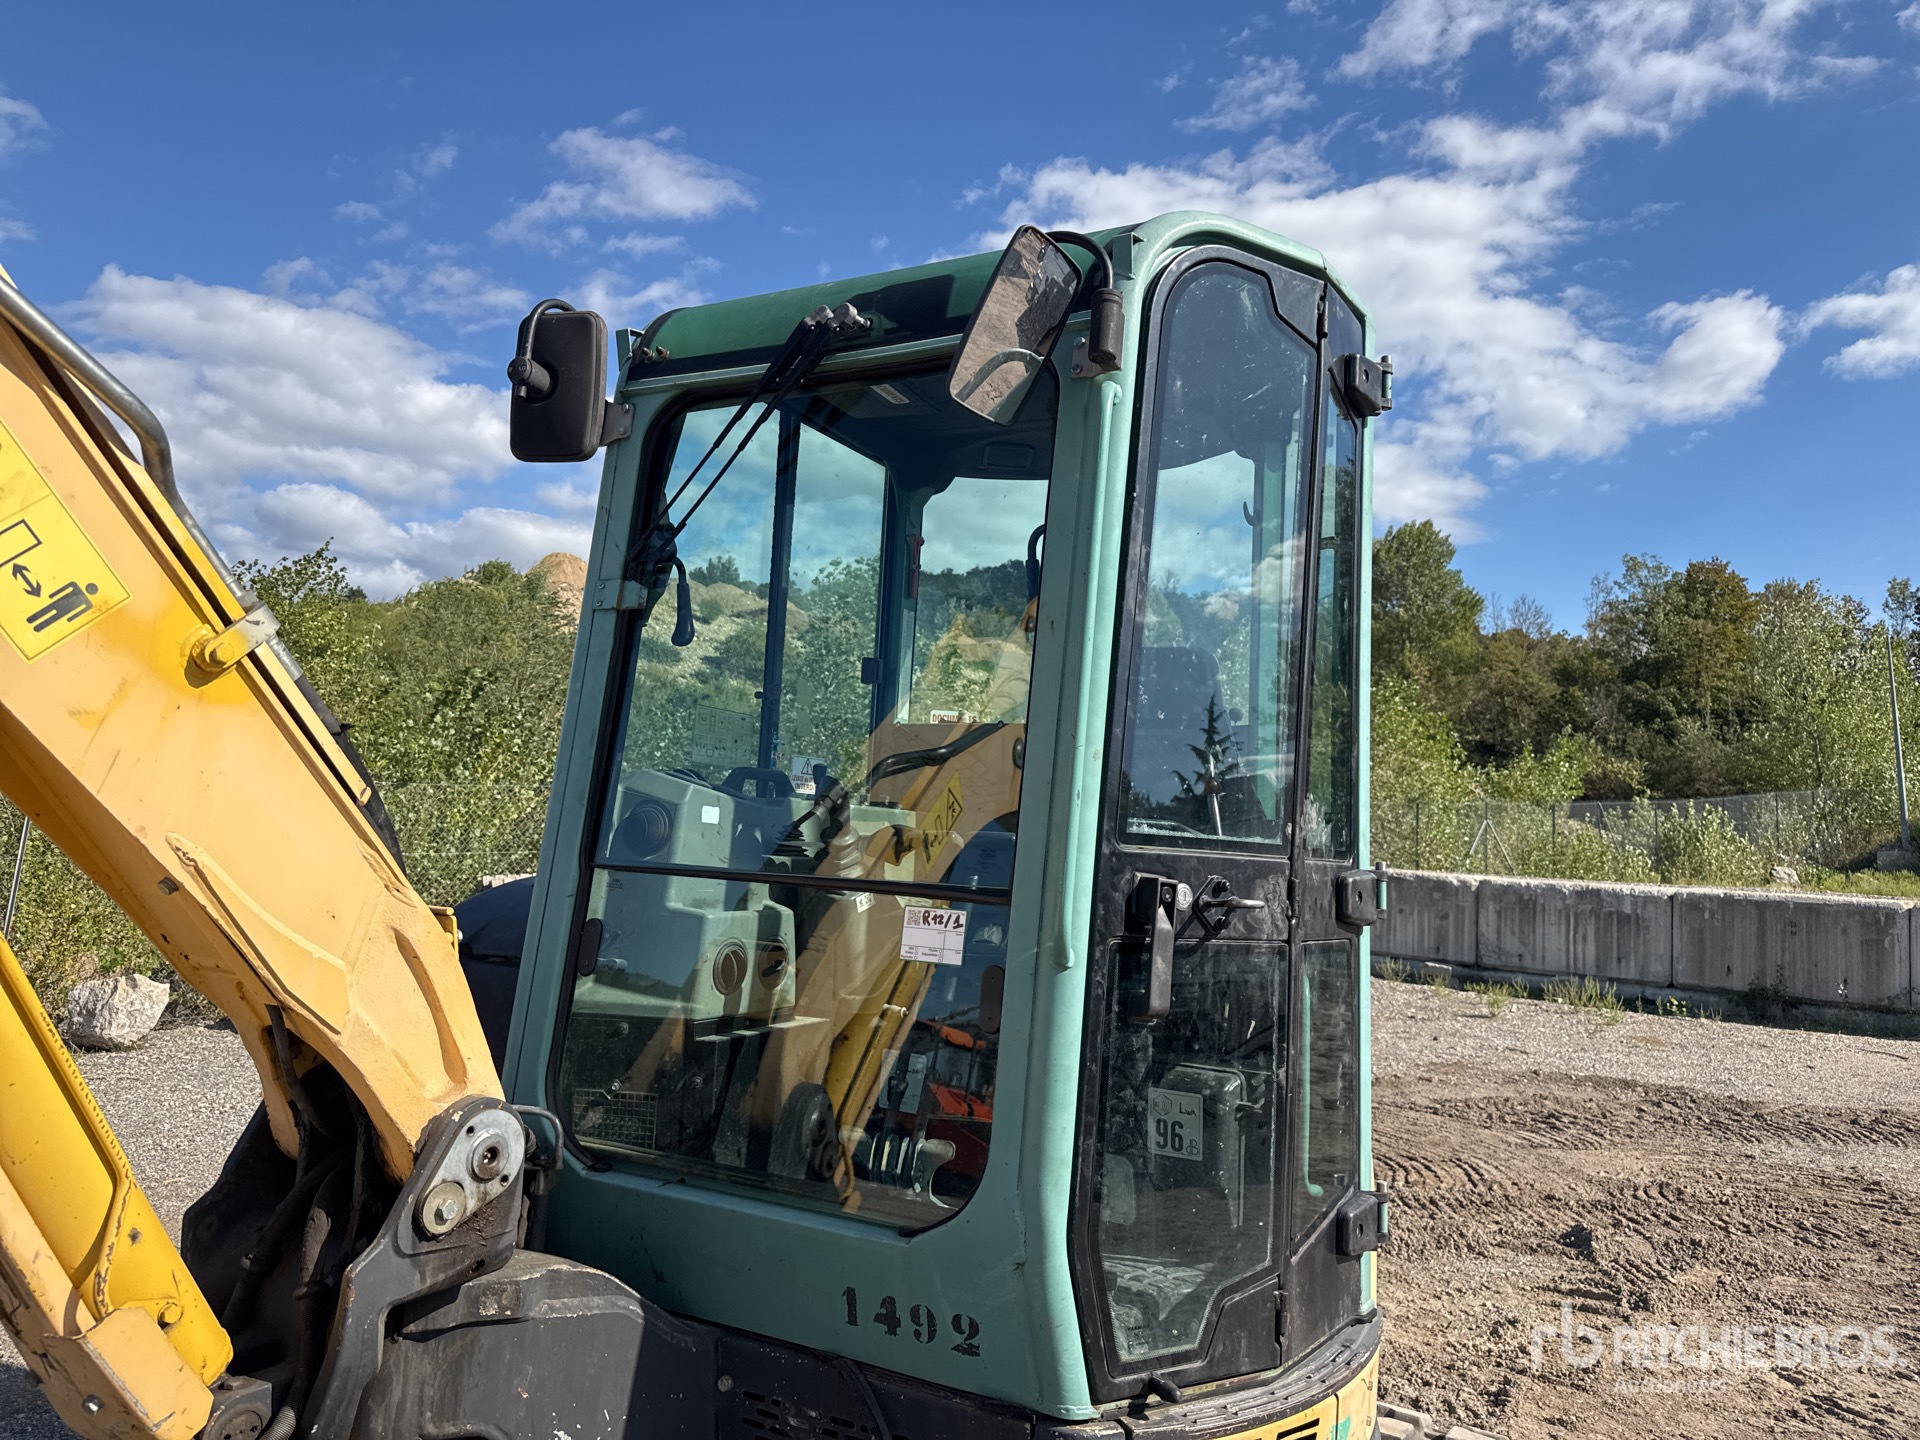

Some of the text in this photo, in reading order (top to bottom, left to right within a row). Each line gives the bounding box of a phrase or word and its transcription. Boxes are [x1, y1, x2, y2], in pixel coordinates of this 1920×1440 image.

[1155, 1118, 1184, 1152] 96
[1186, 1138, 1199, 1155] dB
[841, 1286, 981, 1357] 1492
